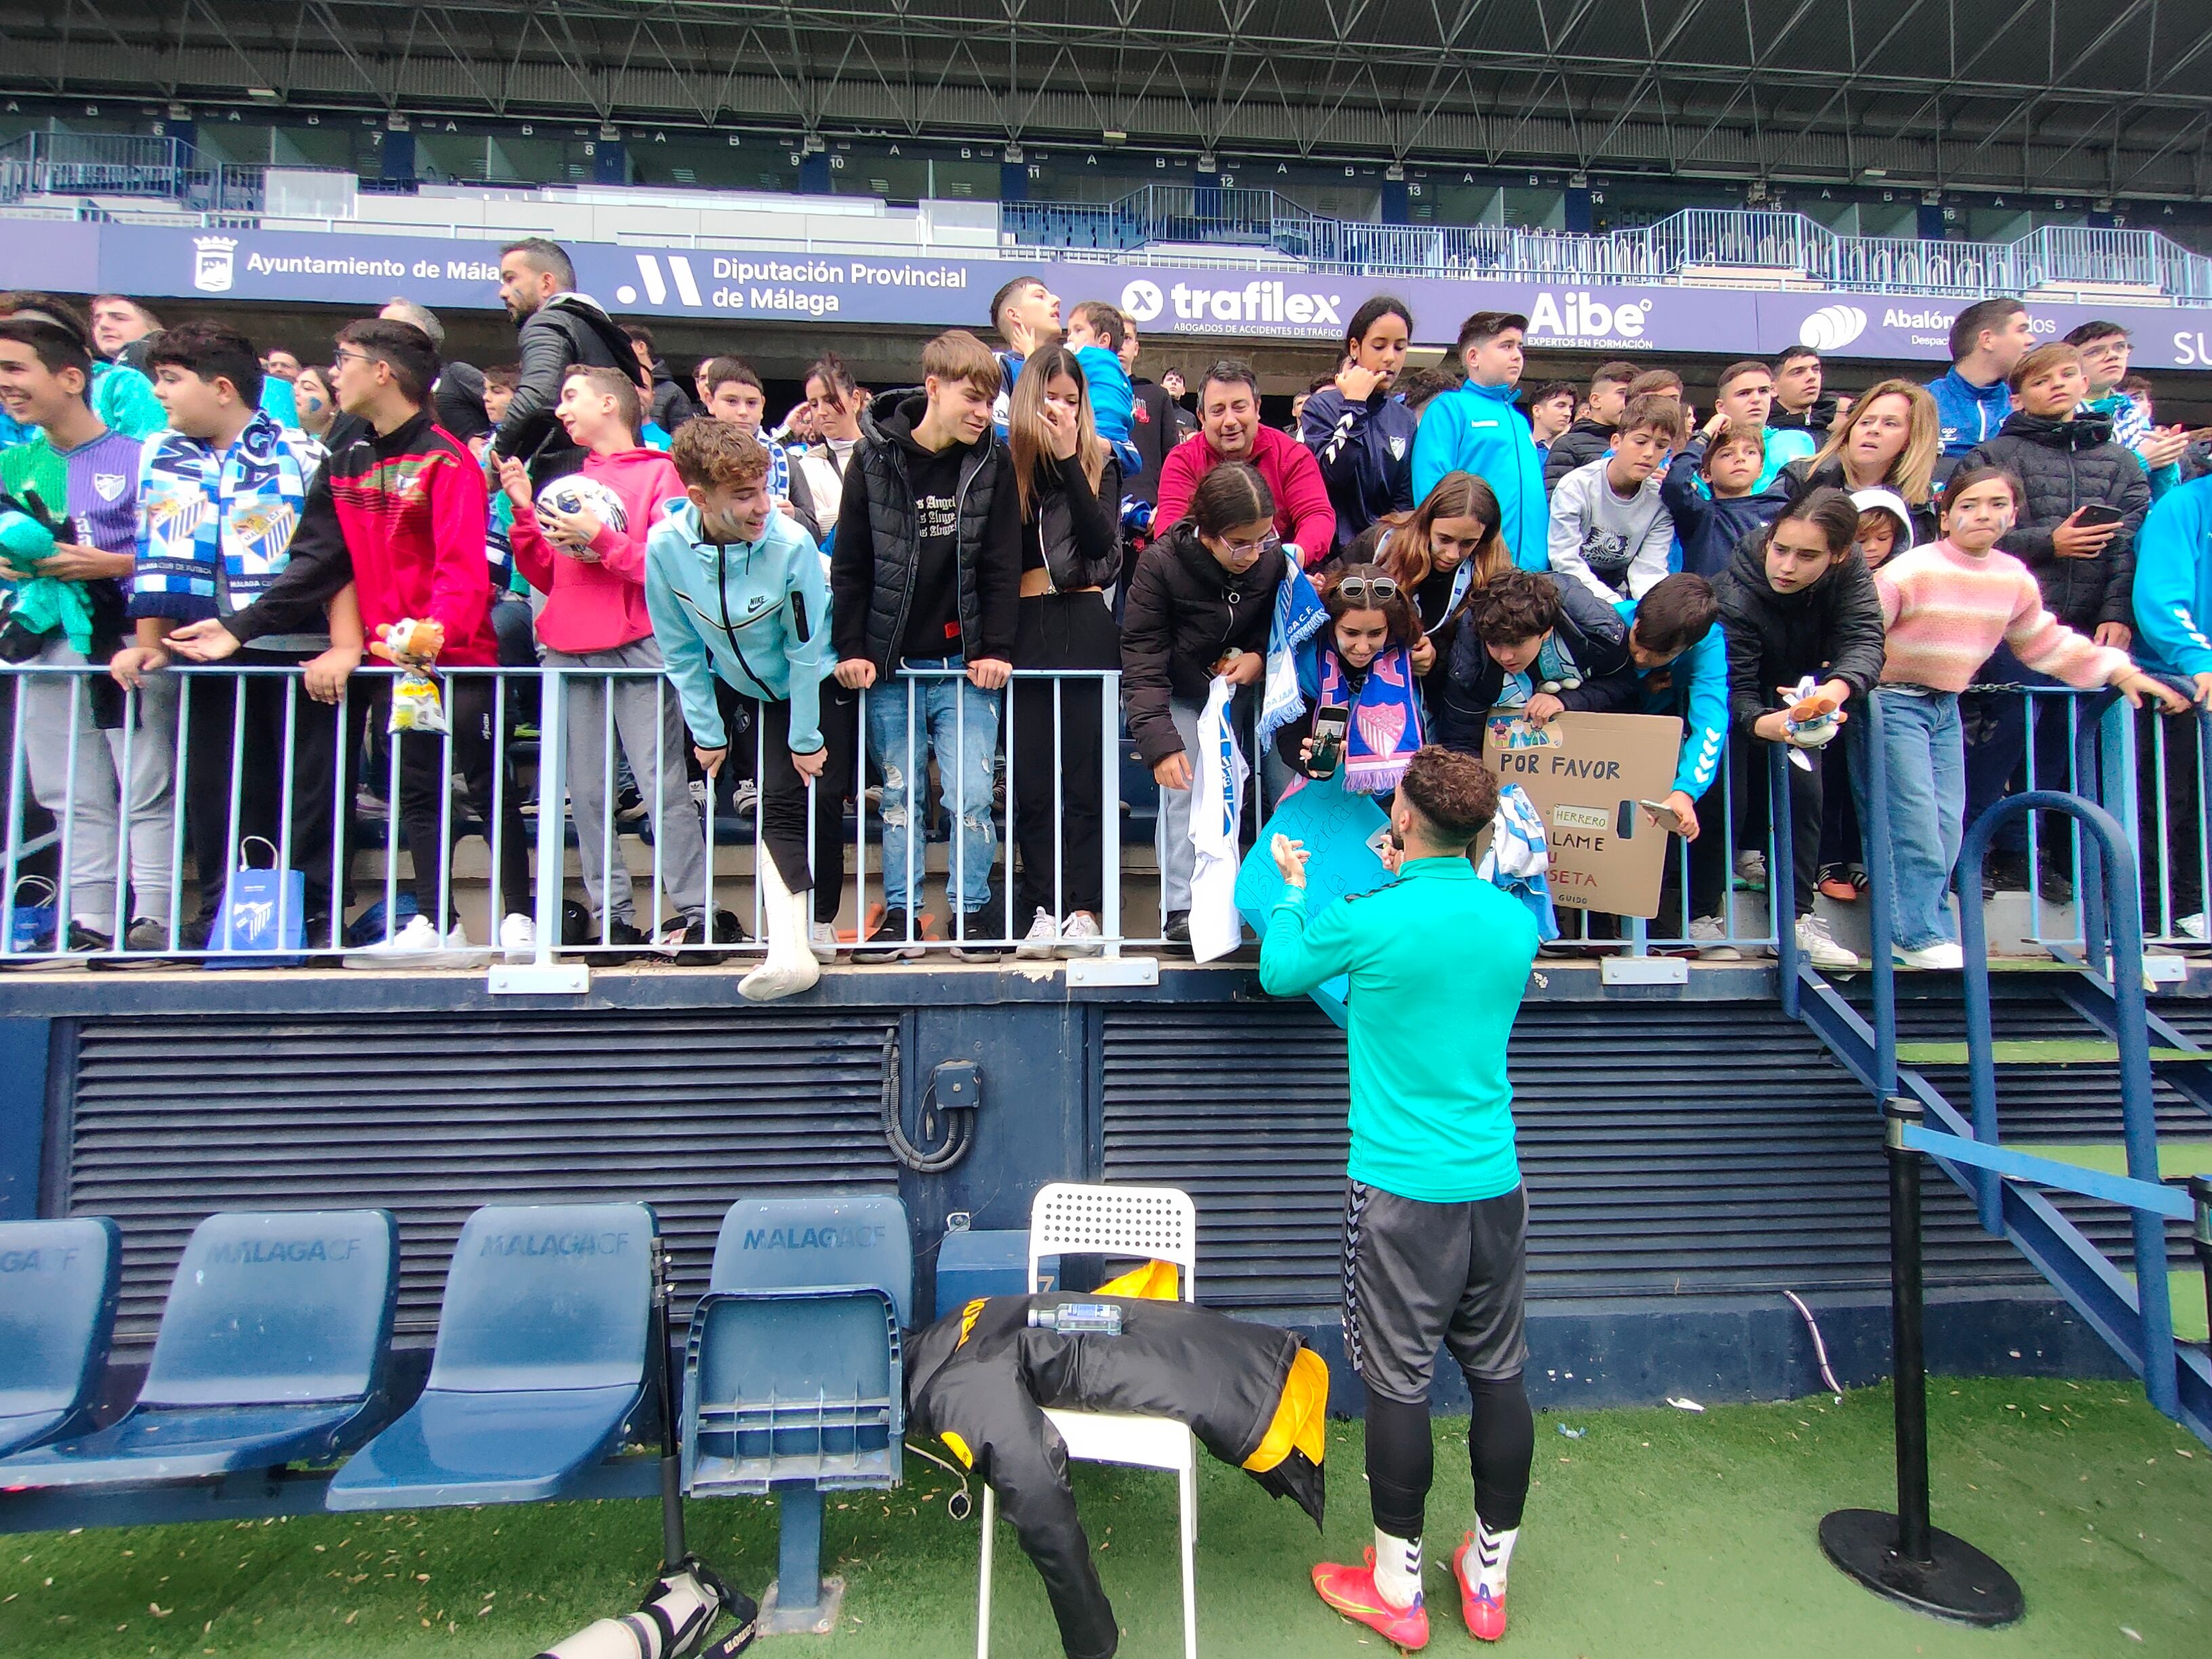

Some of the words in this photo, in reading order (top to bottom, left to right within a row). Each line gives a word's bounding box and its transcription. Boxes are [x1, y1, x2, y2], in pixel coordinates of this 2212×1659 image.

[228, 112, 241, 121] A
[308, 114, 320, 125] B
[152, 125, 163, 136] 6
[445, 121, 457, 132] A
[522, 125, 533, 136] B
[373, 134, 382, 145] 7
[655, 132, 666, 142] A
[729, 136, 740, 146] B
[585, 144, 594, 156] 8
[889, 144, 900, 156] A
[961, 148, 971, 159] B
[791, 155, 800, 166] 9
[830, 158, 844, 169] 10
[1086, 155, 1097, 165] A
[1155, 158, 1166, 168] B
[1027, 167, 1040, 178] 11
[1277, 163, 1288, 173] A
[1345, 166, 1355, 177] B
[1220, 177, 1234, 188] 12
[1463, 173, 1473, 183] A
[1529, 176, 1539, 186] B
[1408, 186, 1421, 196] 13
[1821, 189, 1831, 199] A
[1883, 192, 1893, 201] B
[1591, 194, 1604, 204] 14
[1994, 197, 2004, 207] A
[2055, 199, 2065, 209] B
[1770, 202, 1782, 212] 15
[1942, 209, 1956, 220] 16
[2113, 218, 2125, 228] 17
[247, 253, 406, 276] Ayuntamiento
[412, 260, 441, 279] de
[447, 262, 500, 282] Mála
[713, 258, 844, 284] Diputación
[851, 262, 967, 288] Provincial
[712, 287, 743, 308] de
[750, 288, 840, 316] Málaga
[1170, 281, 1343, 325] trafilex
[1527, 291, 1645, 337] Aibe
[1882, 308, 1955, 330] Abalón
[1174, 322, 1223, 333] ABOGADOS
[1225, 325, 1237, 333] DE
[1239, 325, 1292, 336] ACCIDENTES
[1294, 327, 1305, 336] DE
[1307, 325, 1343, 337] TRÁFICO
[1527, 337, 1576, 347] EXPERTOS
[1578, 339, 1592, 348] EN
[1593, 337, 1653, 350] FORMACIÓN
[750, 595, 765, 606] NIKE
[1500, 753, 1540, 774] POR
[1551, 756, 1620, 780] FAVOR
[1556, 811, 1606, 827] HERRERO
[1549, 832, 1606, 852] LAME
[1549, 869, 1598, 887] SETA
[1558, 893, 1588, 905] GUIDO
[722, 1618, 757, 1654] Canon
